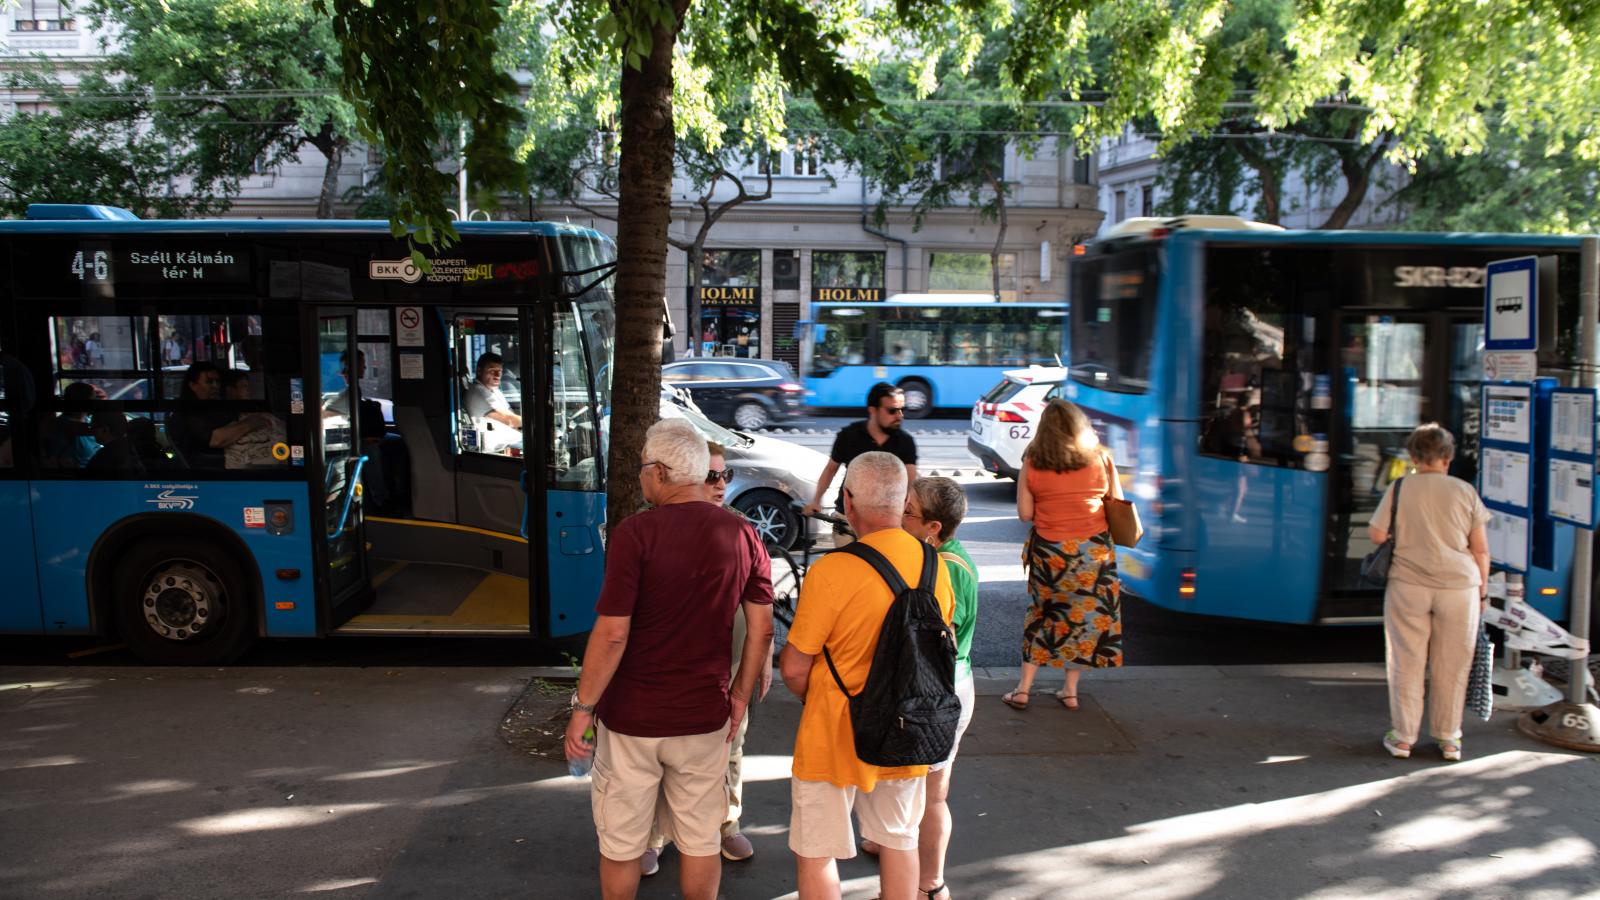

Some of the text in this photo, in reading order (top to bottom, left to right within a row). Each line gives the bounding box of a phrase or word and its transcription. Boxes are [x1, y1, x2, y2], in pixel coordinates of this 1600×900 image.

[130, 251, 234, 264] Széll Kálmán
[71, 251, 108, 280] 4-6
[162, 265, 203, 279] tér M
[377, 266, 399, 274] BKK
[426, 274, 461, 282] KÖZPONT
[819, 288, 880, 301] HOLMI
[1009, 425, 1031, 439] 62
[1562, 713, 1591, 730] 65
